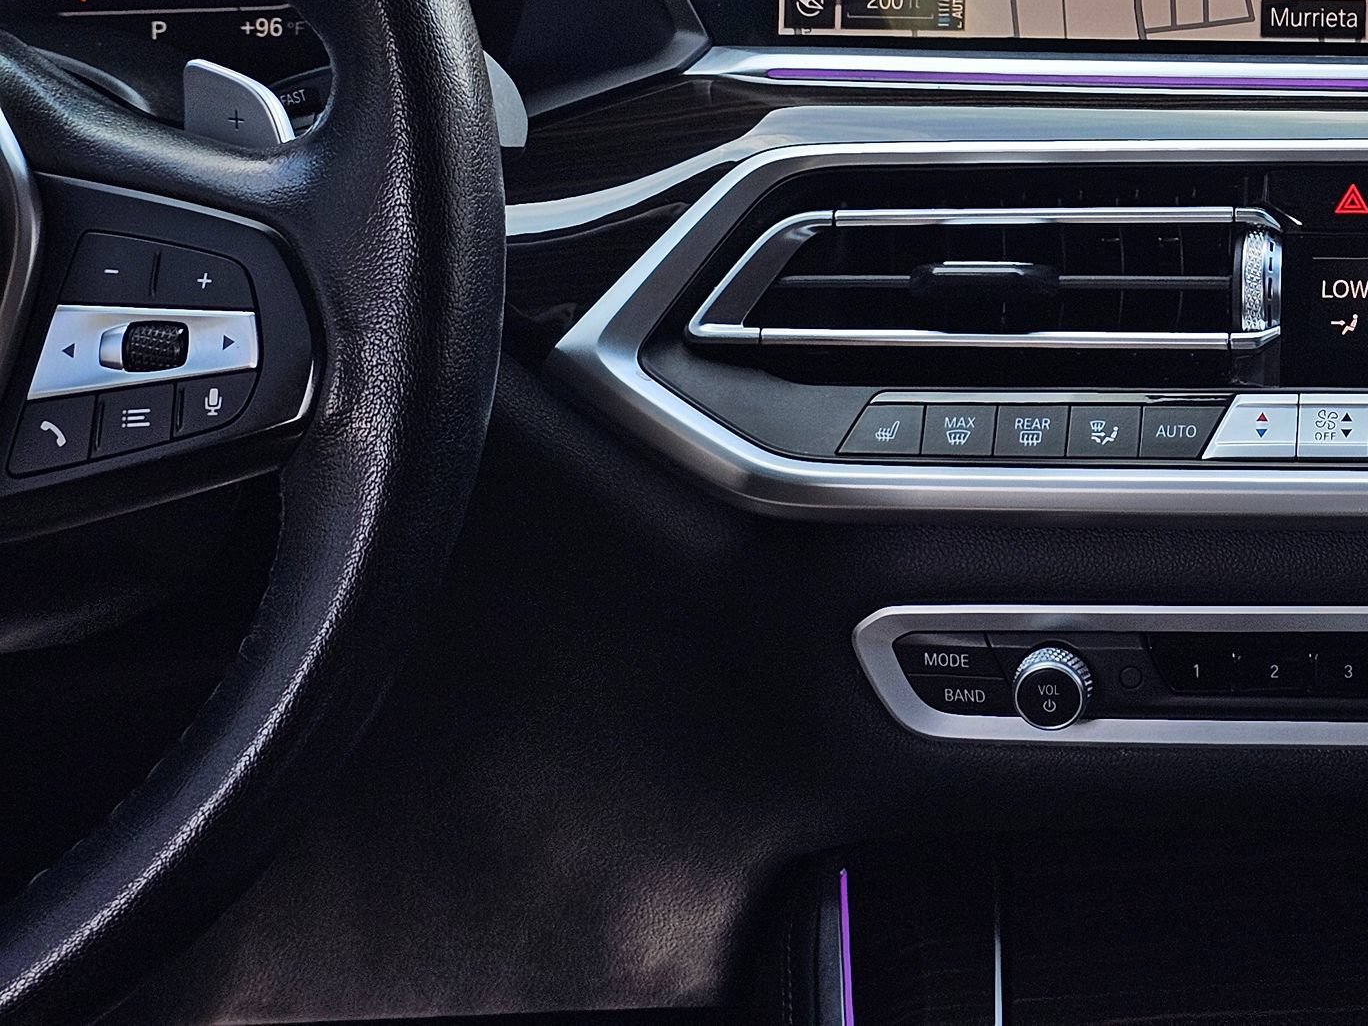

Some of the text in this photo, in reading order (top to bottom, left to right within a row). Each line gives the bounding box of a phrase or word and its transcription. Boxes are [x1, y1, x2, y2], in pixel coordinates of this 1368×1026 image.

[1270, 6, 1359, 29] Murrieta
[151, 20, 168, 41] P
[944, 416, 976, 429] MAX
[1014, 417, 1051, 431] REAR
[1155, 424, 1197, 439] AUTO
[1314, 431, 1337, 442] OFF
[923, 652, 970, 669] MODE
[1192, 664, 1200, 679] 1
[1268, 664, 1280, 679] 2
[1343, 664, 1354, 679] 3
[943, 687, 986, 704] BAND
[1037, 684, 1061, 696] VOL
